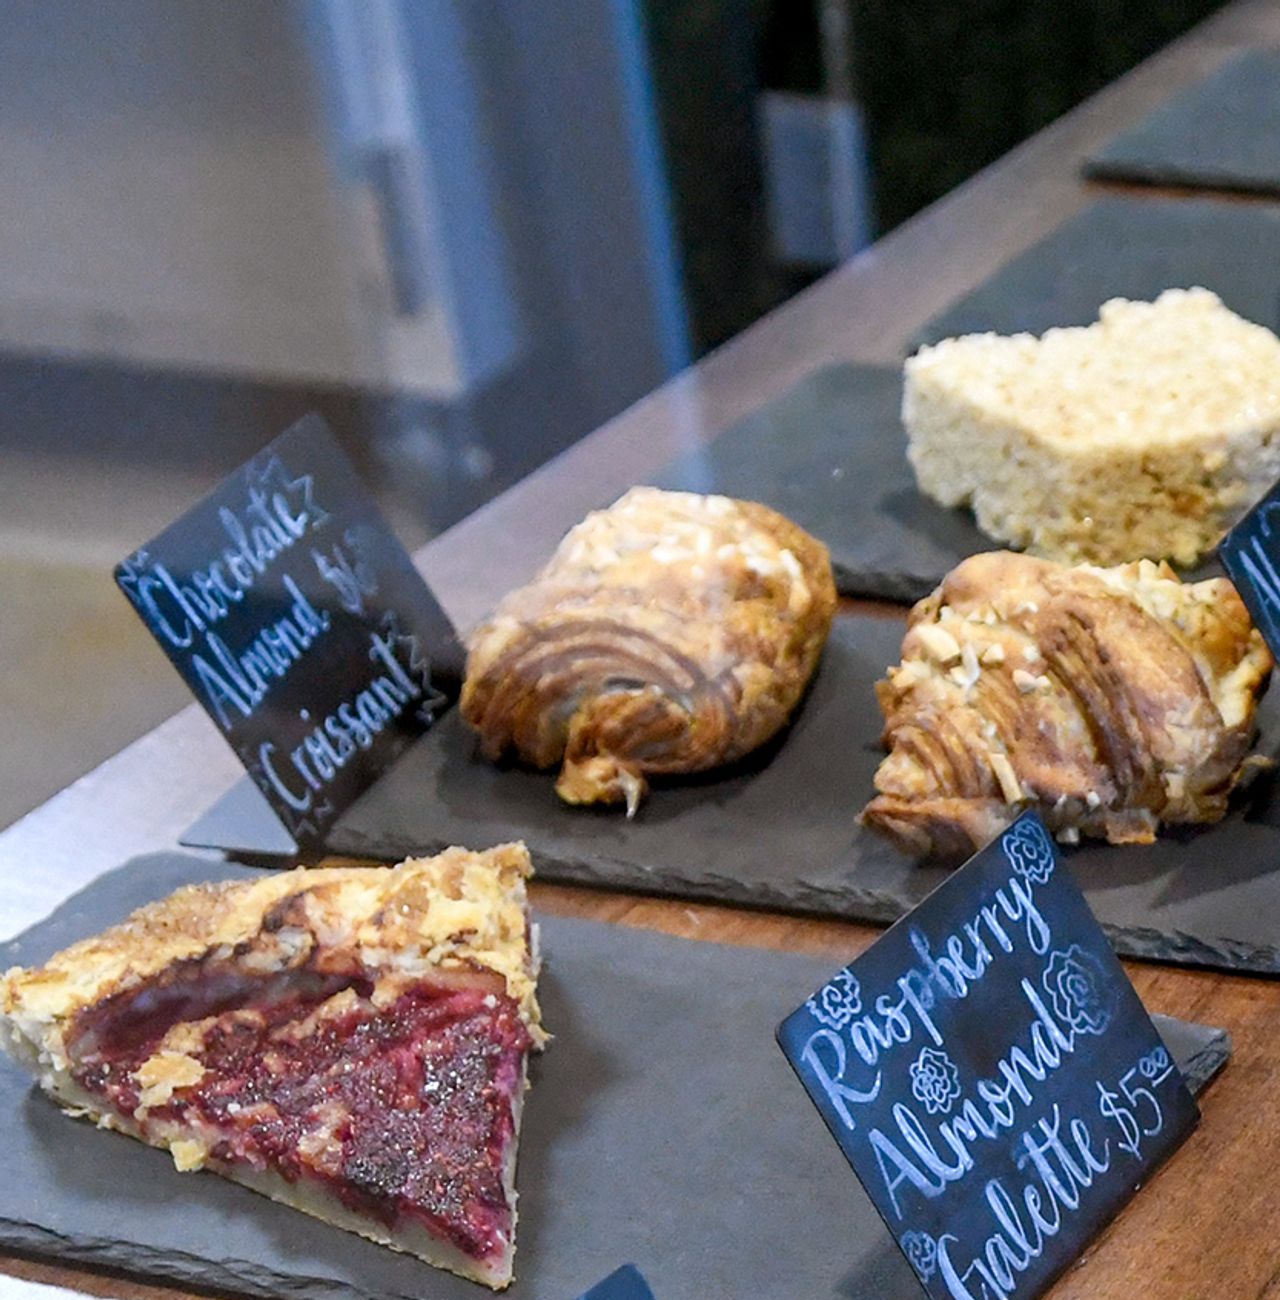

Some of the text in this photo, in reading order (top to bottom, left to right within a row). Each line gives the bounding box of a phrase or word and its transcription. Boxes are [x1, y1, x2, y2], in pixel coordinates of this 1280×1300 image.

[139, 485, 307, 648] Chocolate
[192, 575, 330, 728] Almond
[259, 632, 424, 812] Croissant
[801, 874, 1052, 1131] Raspberry
[867, 977, 1075, 1222] Almond
